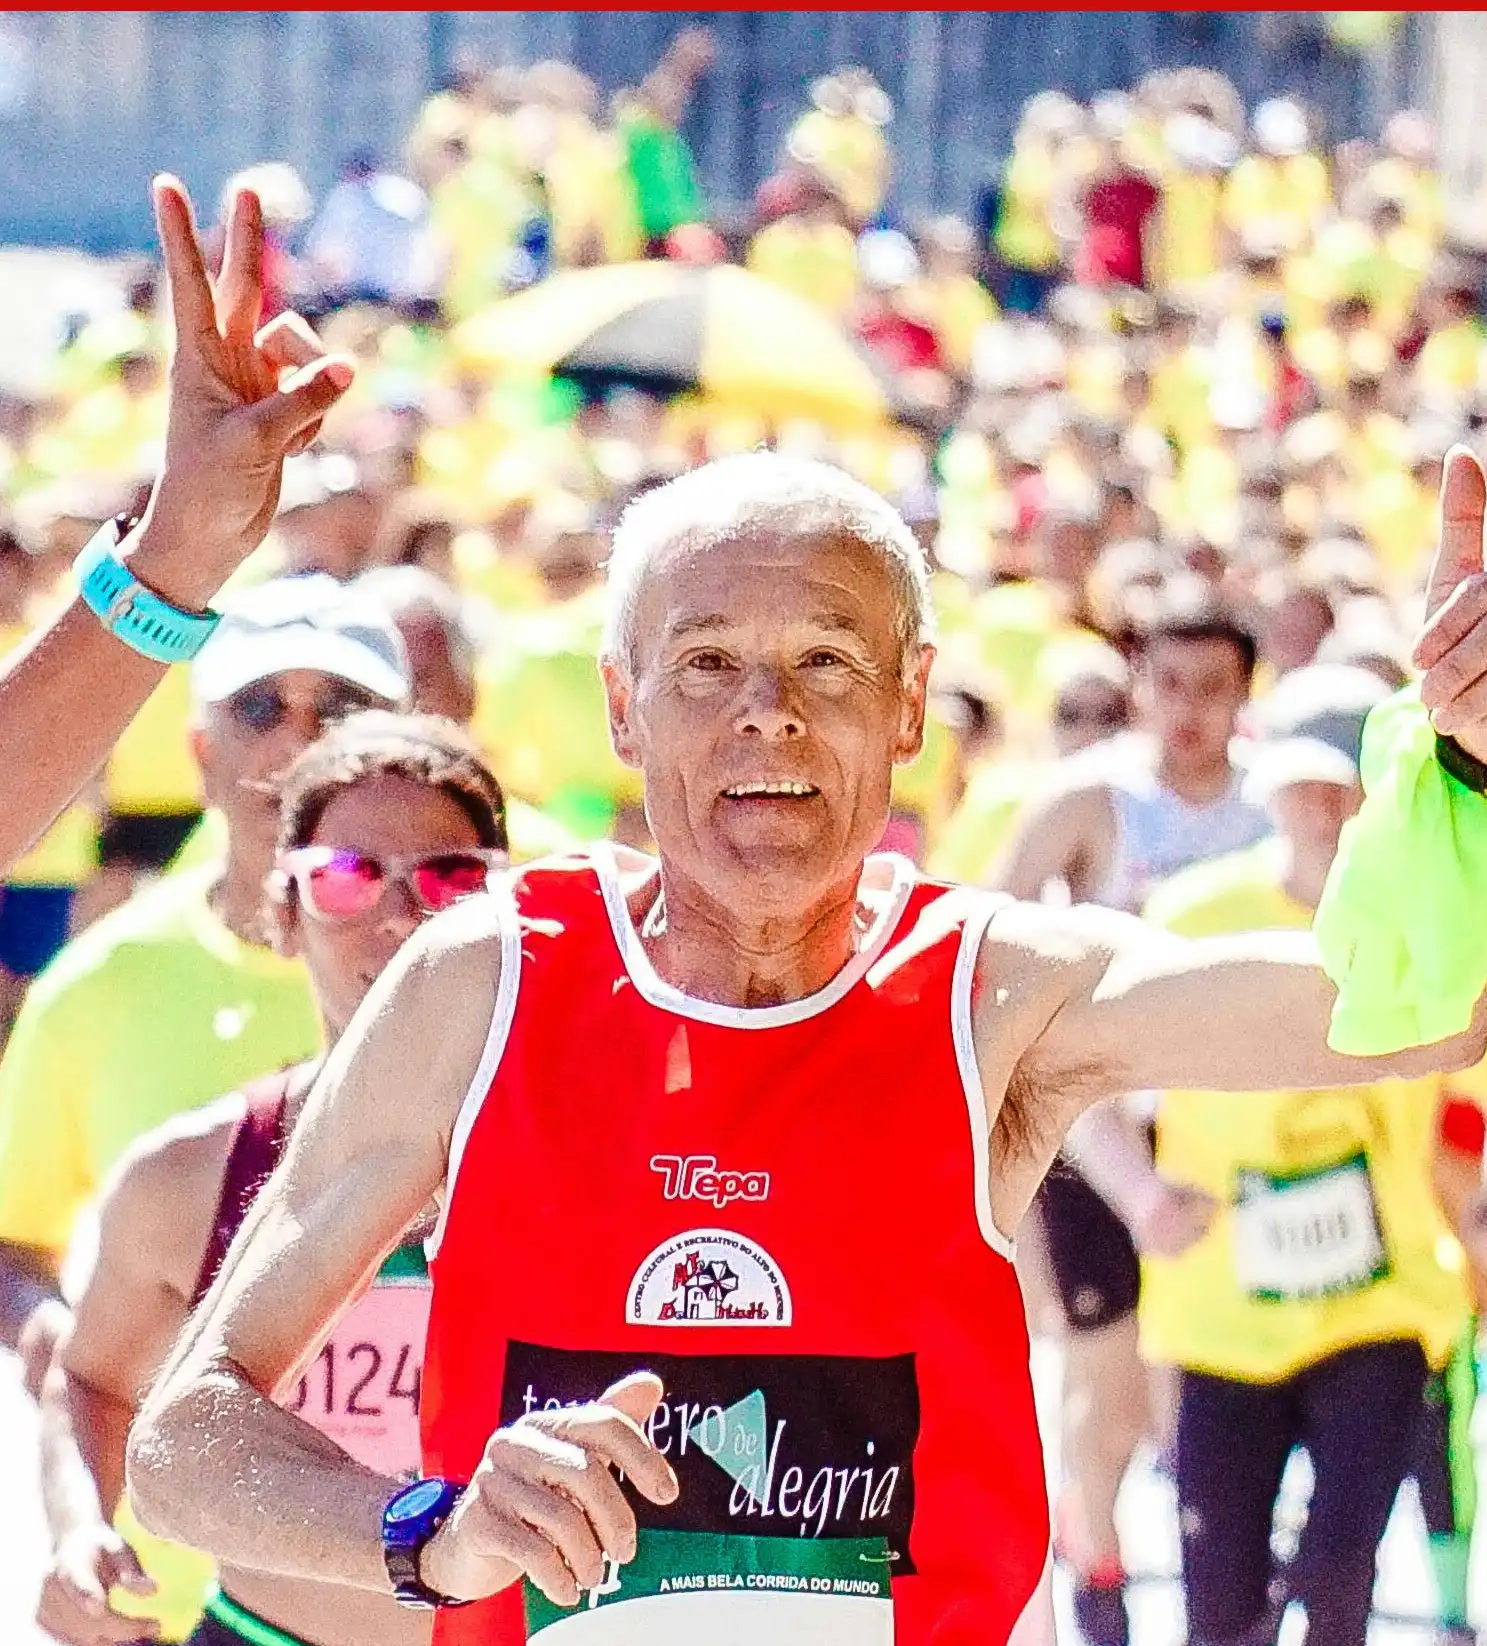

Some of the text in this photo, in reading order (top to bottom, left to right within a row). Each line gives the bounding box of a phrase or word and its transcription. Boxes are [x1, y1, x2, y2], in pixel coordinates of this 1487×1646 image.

[734, 1425, 757, 1456] de
[728, 1418, 900, 1538] alegria
[659, 1574, 880, 1594] A MAIS BELA CORRIDA DO MUNDO
